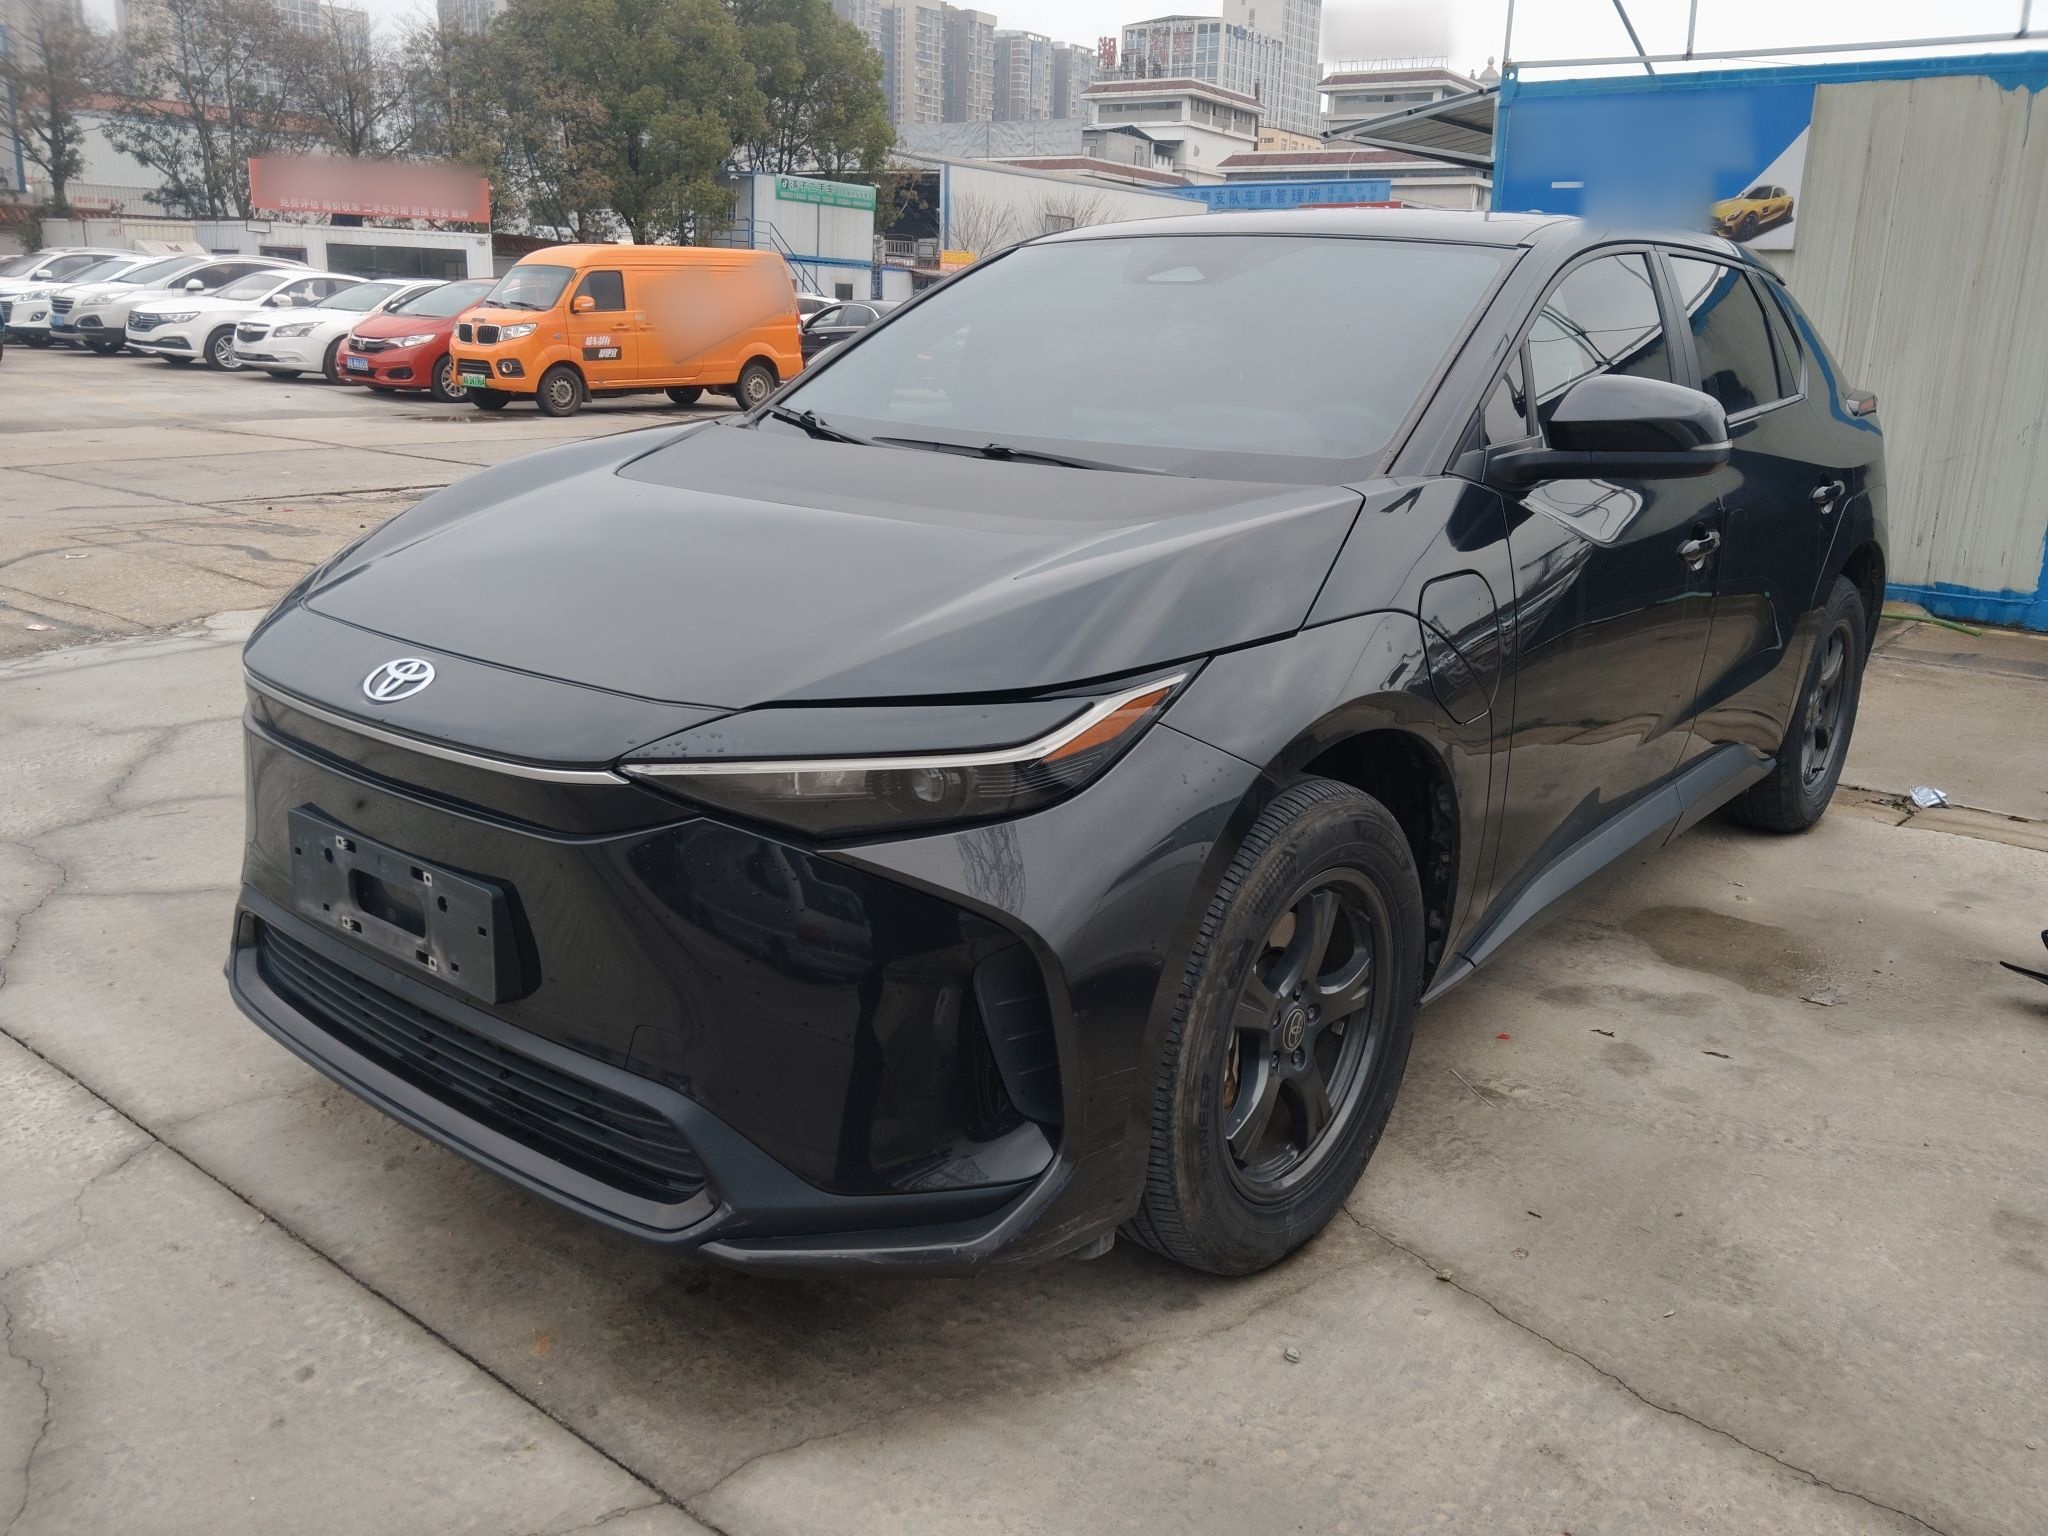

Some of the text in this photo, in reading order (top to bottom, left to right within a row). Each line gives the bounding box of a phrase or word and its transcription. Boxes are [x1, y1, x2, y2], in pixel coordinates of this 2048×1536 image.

[280, 197, 319, 209] 免费评估
[322, 200, 360, 212] 高价收车
[1198, 1073, 1211, 1181] PIONEER
